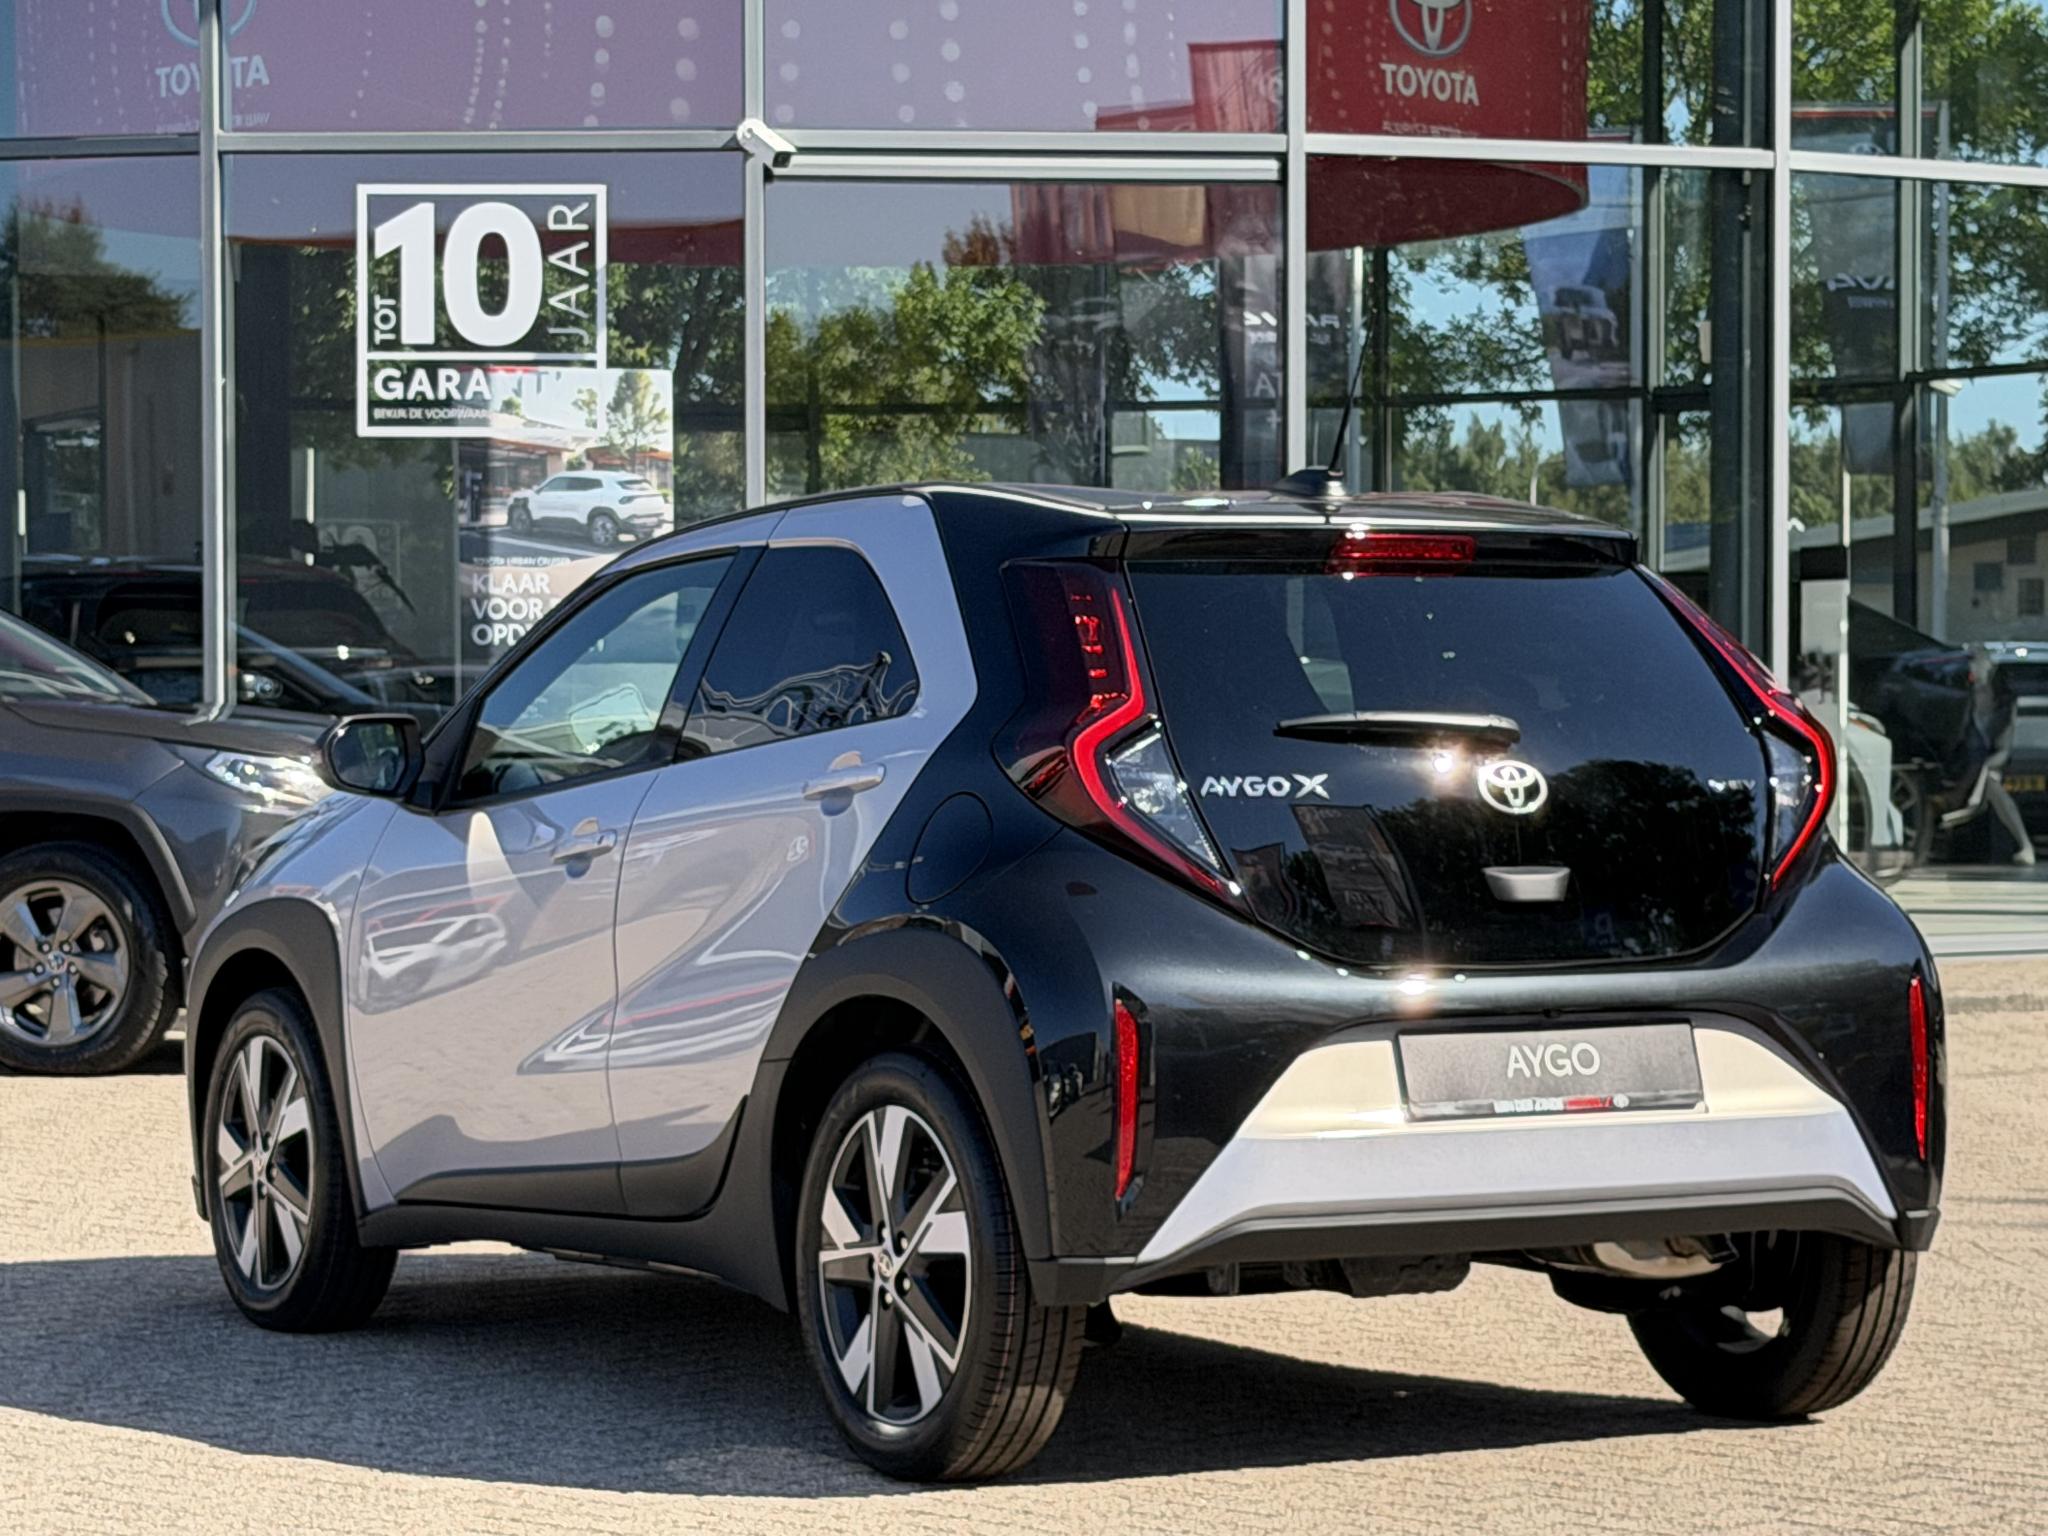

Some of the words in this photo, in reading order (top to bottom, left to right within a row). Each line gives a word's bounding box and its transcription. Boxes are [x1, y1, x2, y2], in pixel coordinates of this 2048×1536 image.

[155, 54, 270, 98] TOYTA
[1379, 63, 1479, 107] TOYOTA
[374, 201, 543, 347] 10
[547, 202, 590, 345] JAAR
[373, 294, 397, 345] TOT
[472, 572, 550, 594] KLAAR
[470, 598, 545, 621] VOOR
[1201, 776, 1291, 797] AYGO
[1507, 1042, 1600, 1078] AYGO
